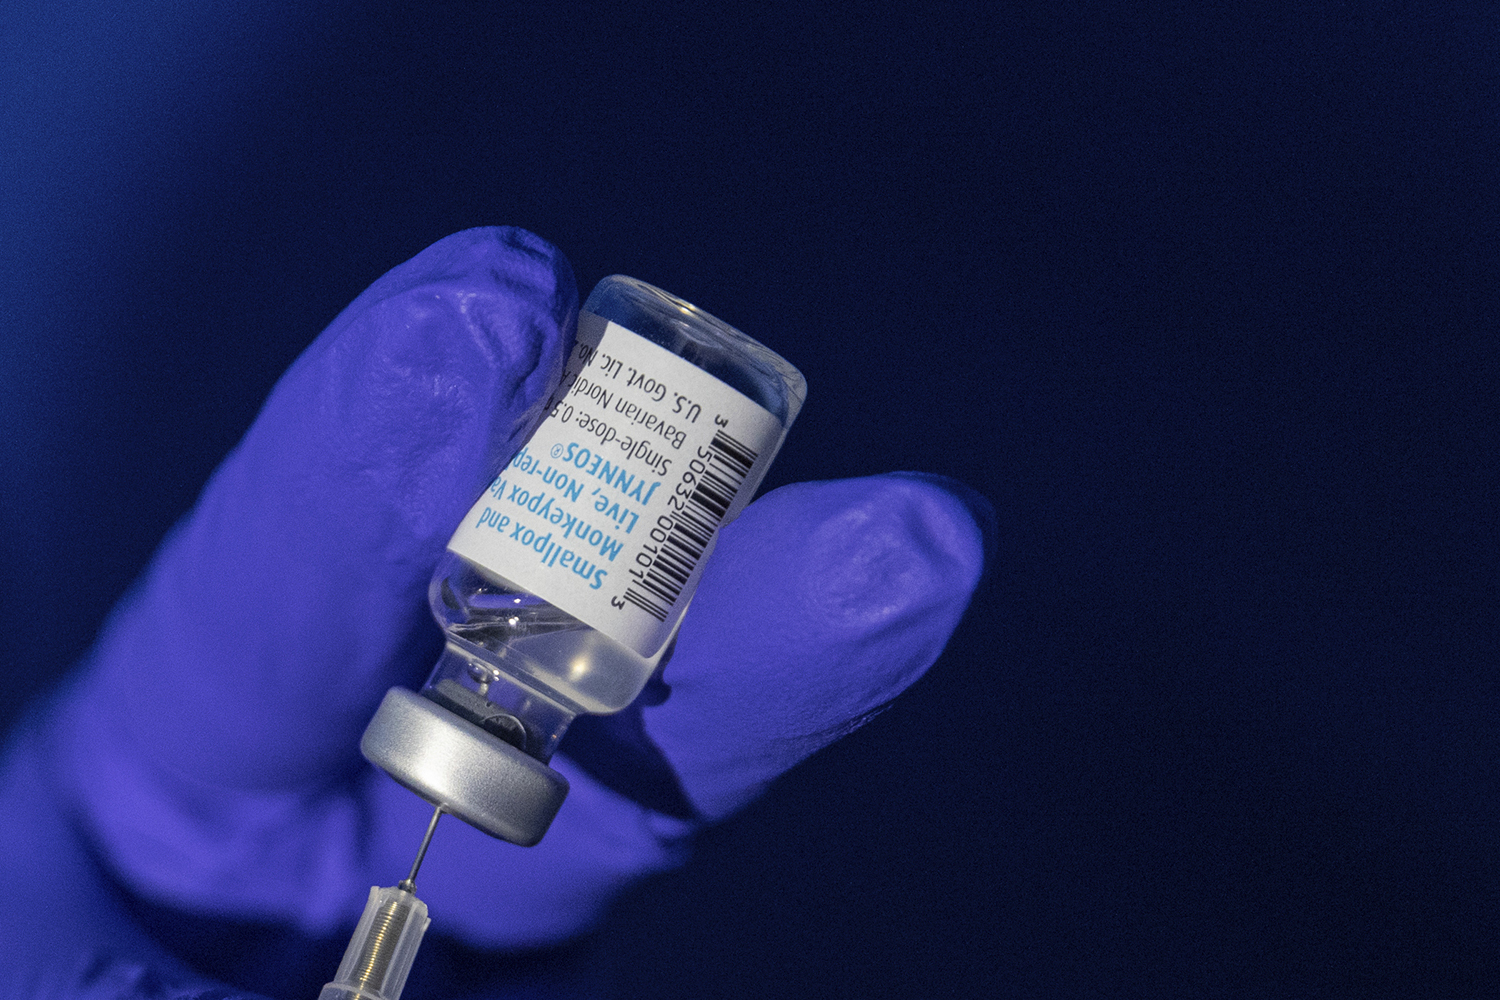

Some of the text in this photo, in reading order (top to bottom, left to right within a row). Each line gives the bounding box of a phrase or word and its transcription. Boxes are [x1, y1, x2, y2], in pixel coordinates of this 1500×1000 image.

[567, 373, 614, 409] Nordic
[600, 353, 623, 379] Lic.
[626, 366, 667, 402] Govt.
[615, 397, 687, 450] Bavarian
[672, 391, 702, 424] U.S.
[575, 410, 673, 477] Single-dose:
[505, 447, 640, 534] Live, Non-rep
[611, 413, 729, 611] 3 50632 00101 3
[475, 507, 609, 590] Smallpox and
[507, 484, 624, 562] Monkeypox
